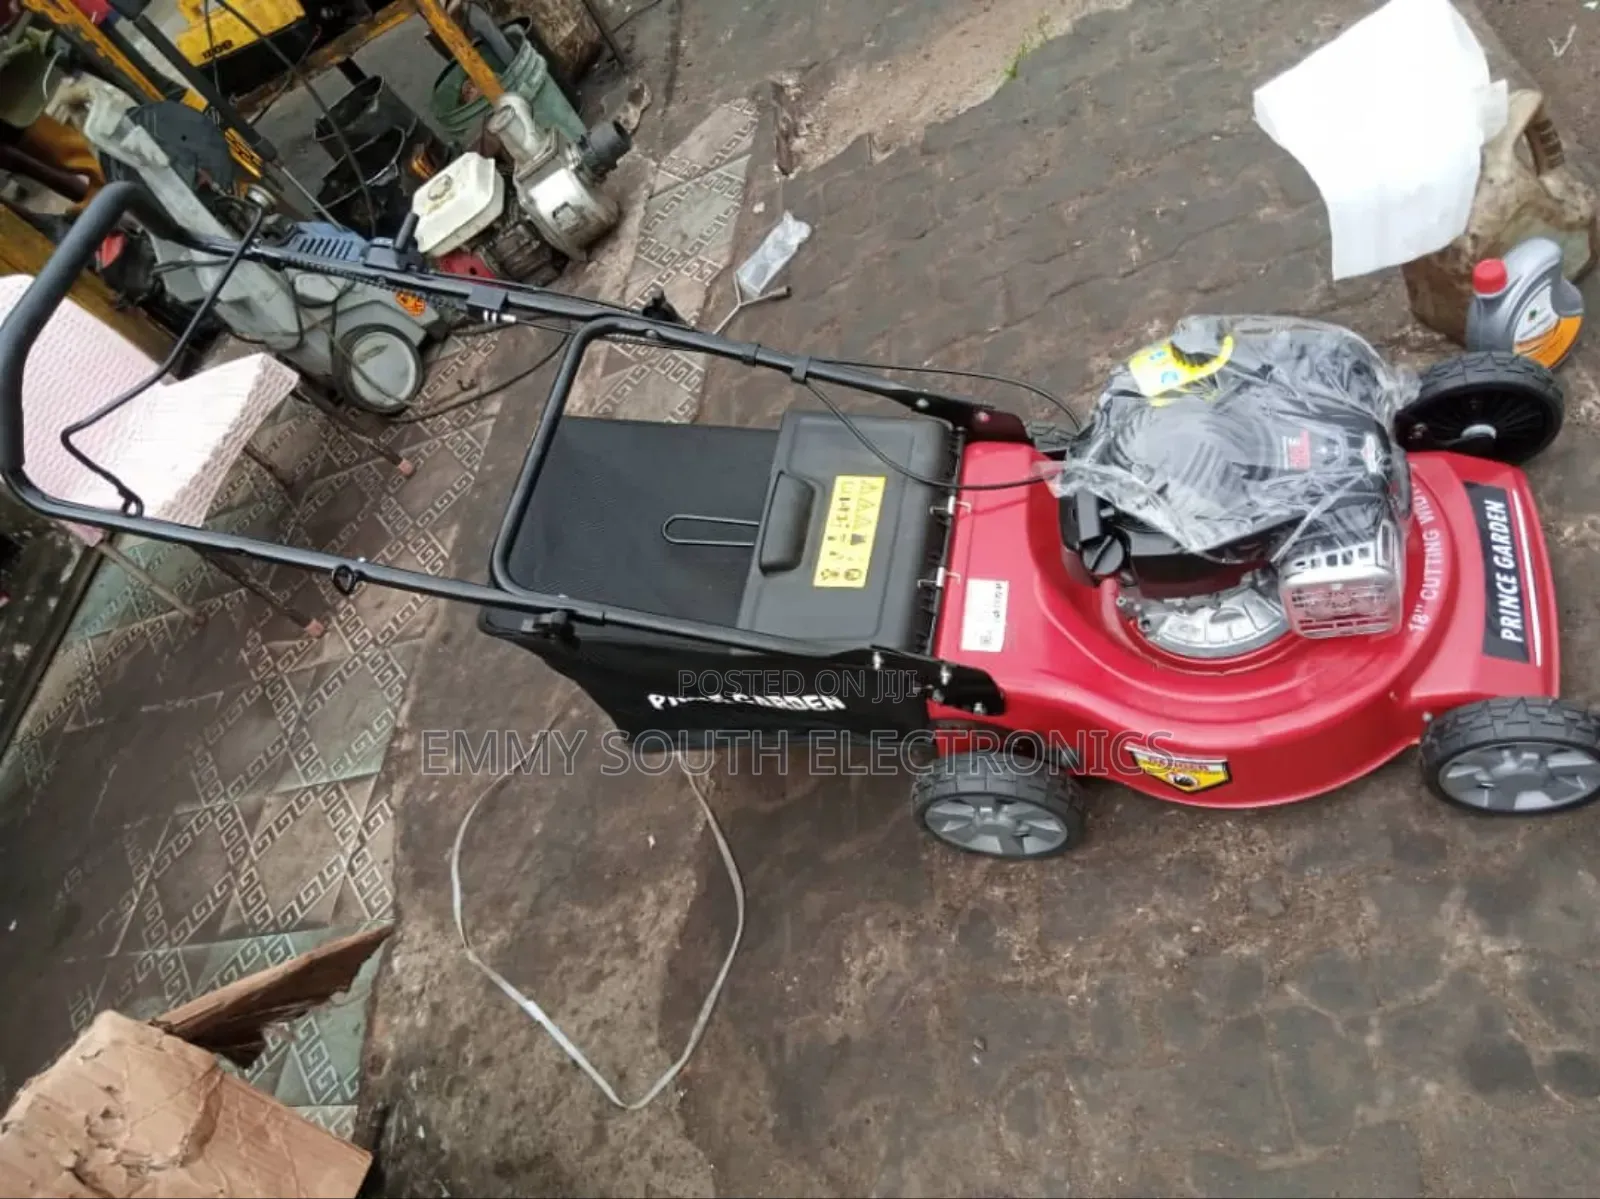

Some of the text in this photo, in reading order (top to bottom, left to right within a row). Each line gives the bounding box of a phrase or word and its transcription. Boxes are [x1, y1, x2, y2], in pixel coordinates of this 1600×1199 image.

[1408, 604, 1431, 632] 18"
[1420, 529, 1442, 601] CUTTING
[1484, 499, 1523, 642] PRINCE GARDEN
